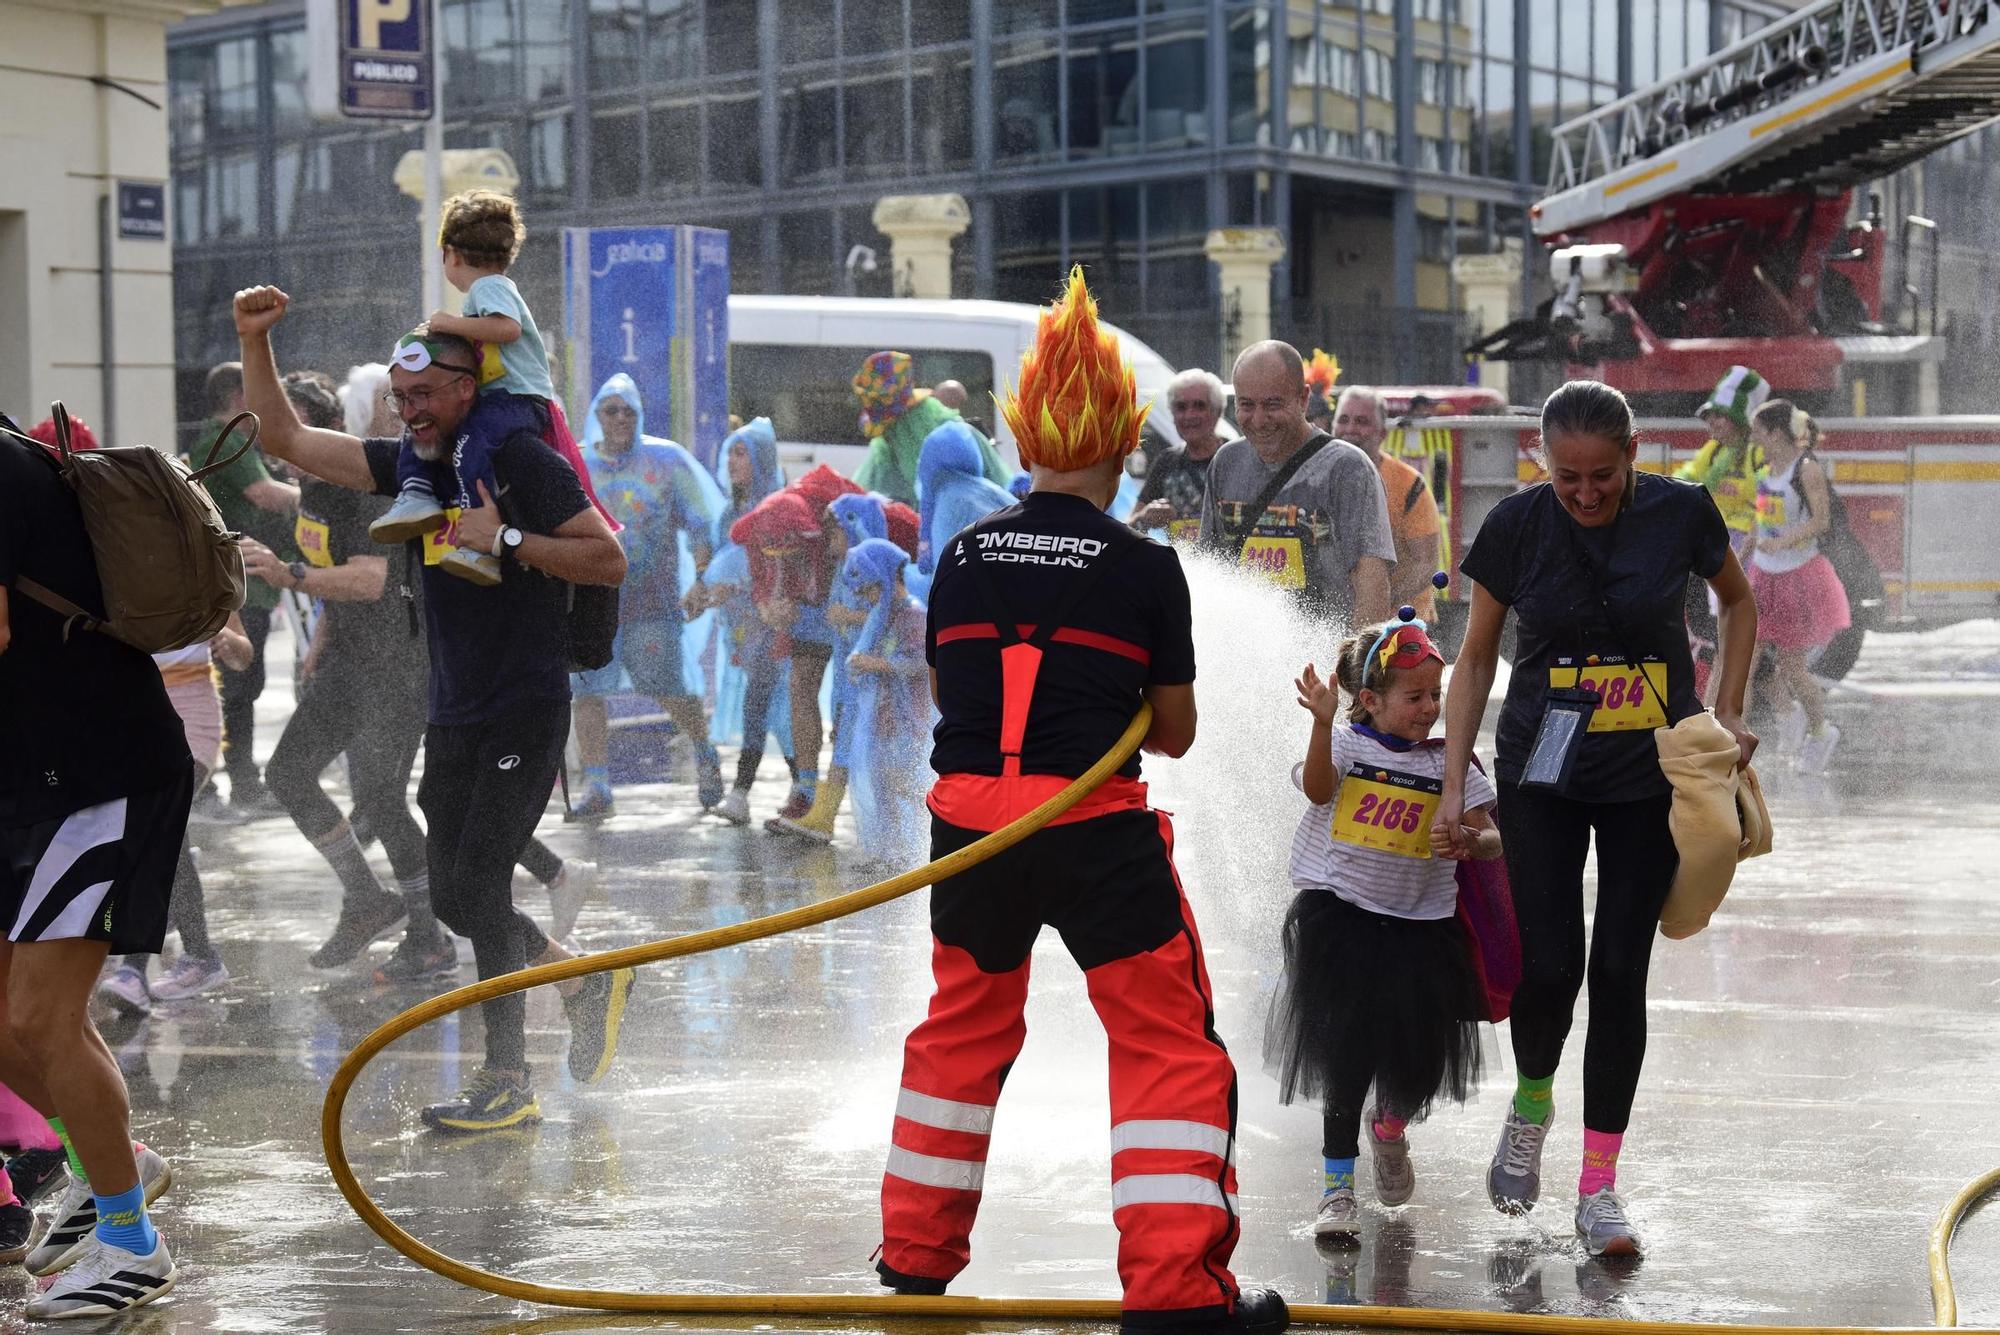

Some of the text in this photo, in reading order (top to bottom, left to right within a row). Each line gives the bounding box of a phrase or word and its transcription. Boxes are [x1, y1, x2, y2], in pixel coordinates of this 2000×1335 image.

[360, 0, 411, 48] P
[955, 532, 1109, 557] OMBEIRO
[981, 552, 1089, 569] CORUÑ
[1390, 775, 1416, 787] repsol
[1352, 793, 1425, 834] 2185
